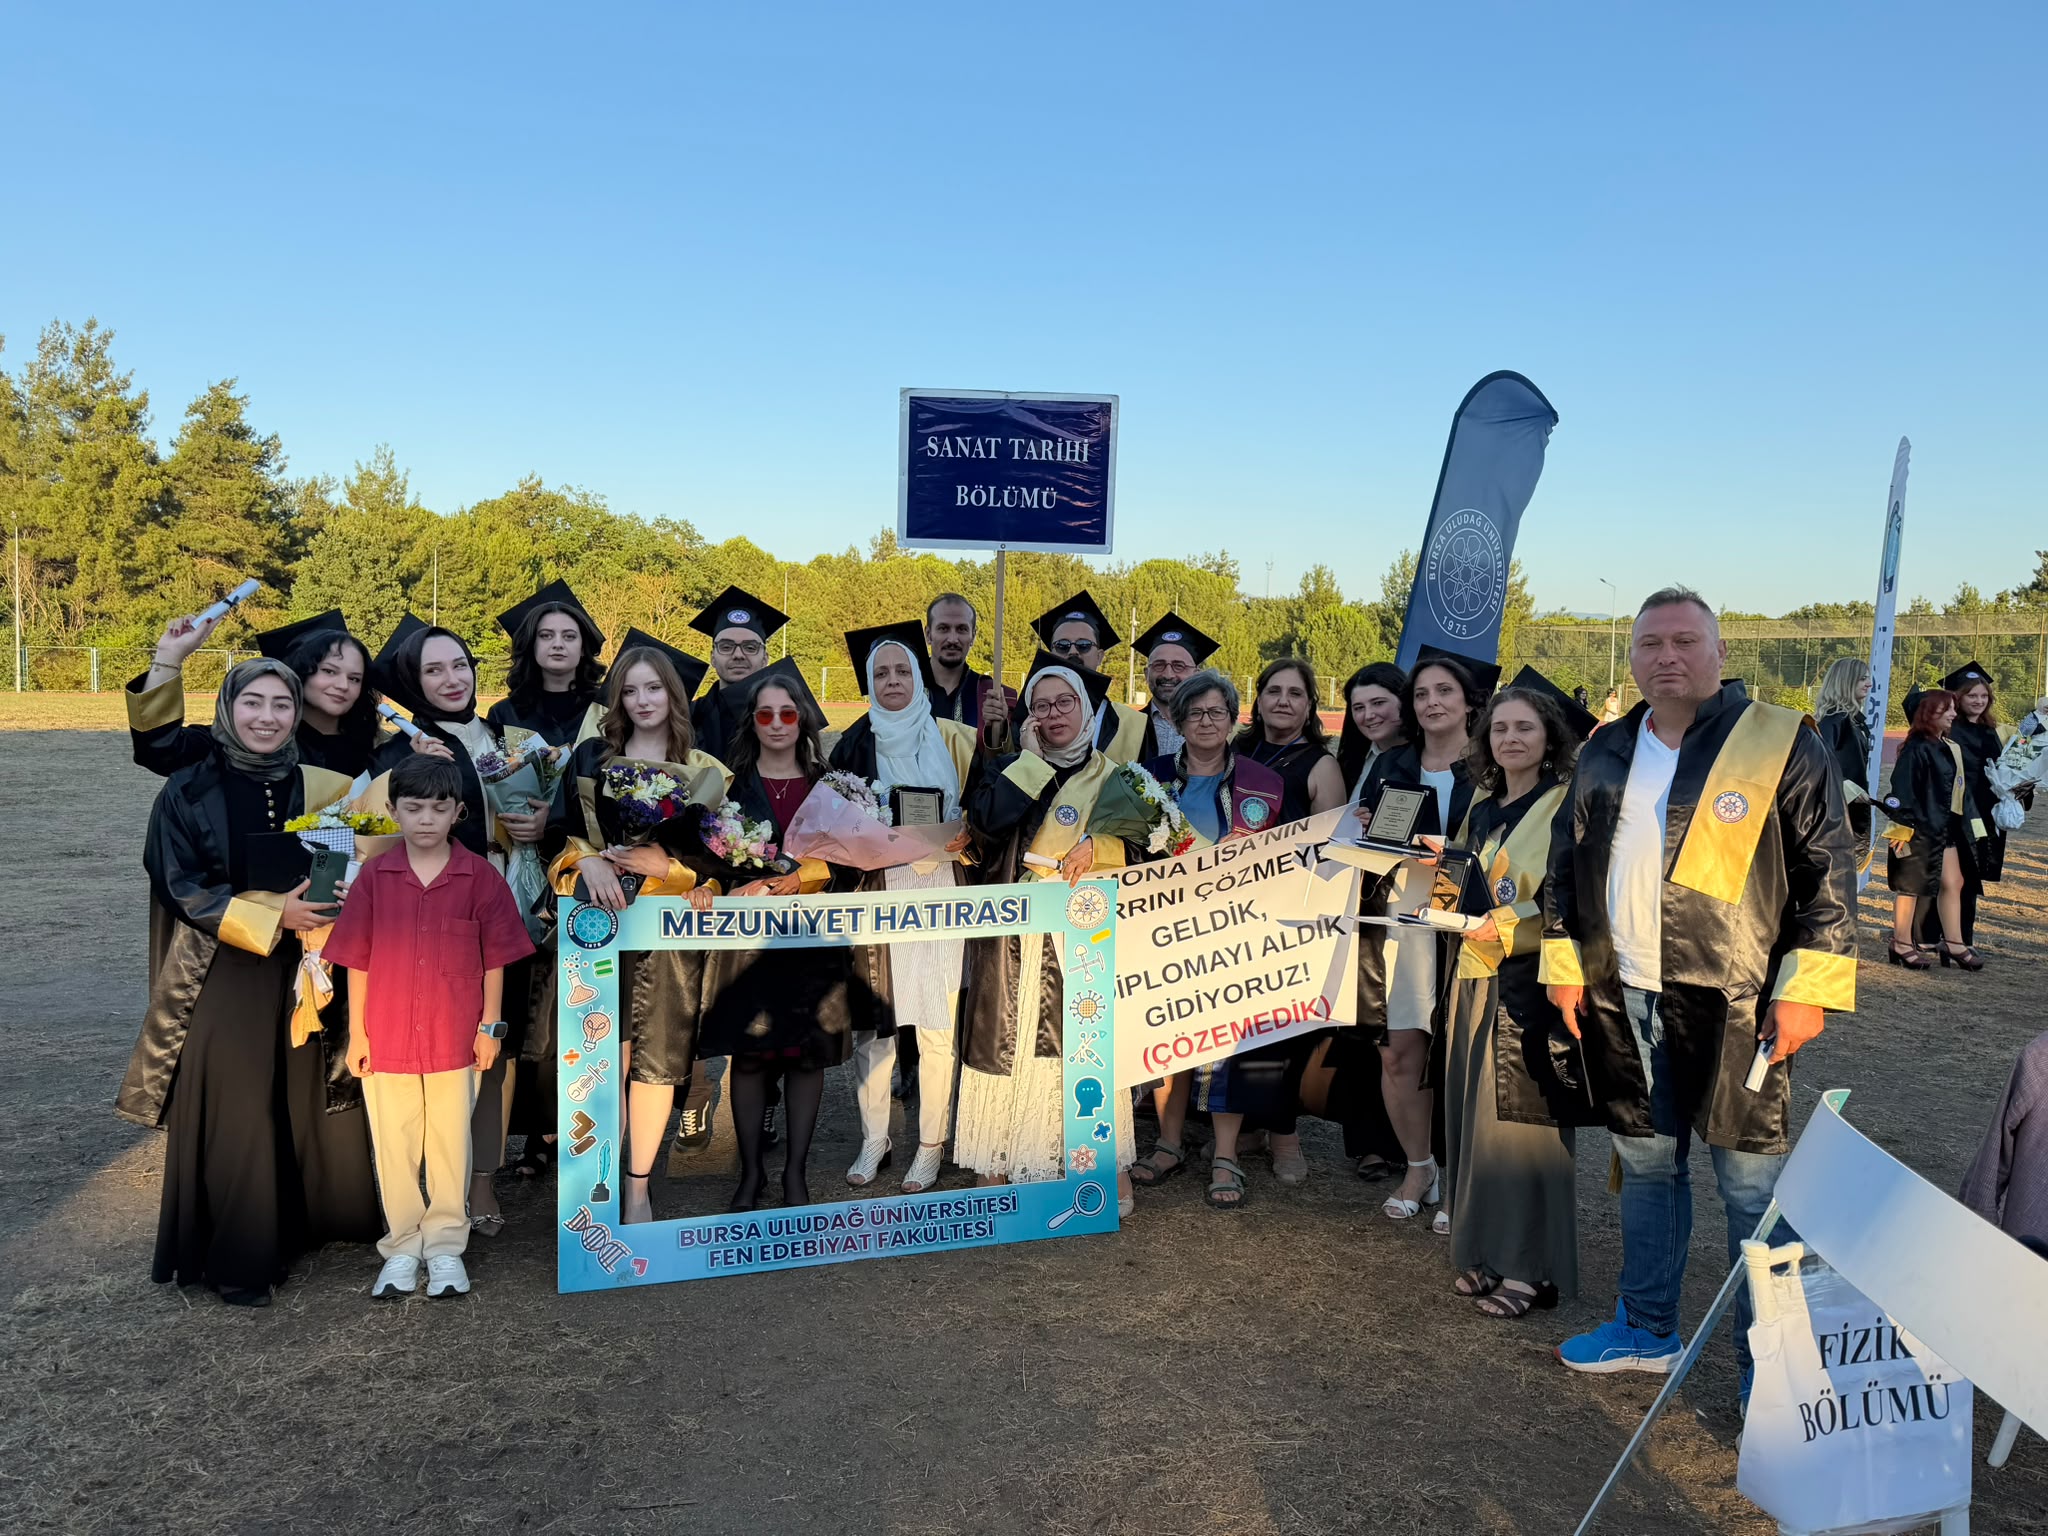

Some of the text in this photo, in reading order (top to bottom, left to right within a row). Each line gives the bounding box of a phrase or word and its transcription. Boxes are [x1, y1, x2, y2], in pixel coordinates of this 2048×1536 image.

[927, 435, 1090, 463] SANAT TARİHİ
[955, 485, 1059, 509] BÖLÜMÜ
[1429, 534, 1447, 580] BURSA
[1445, 513, 1483, 534] ULUDAĞ
[1442, 615, 1467, 636] 1975
[1096, 862, 1188, 889] ONA
[1195, 840, 1332, 901] ÇÖZMEYE
[662, 901, 867, 938] MEZUNİYET
[873, 896, 1031, 934] HATIRASI
[1151, 899, 1268, 948] GELDİK,
[1114, 915, 1348, 1000] İPLOMAYI ALDIK
[1145, 962, 1312, 1028] GİDİYORUZ!
[1142, 995, 1332, 1074] (ÇÖZEMEDİK)
[680, 1190, 1018, 1248] BURSA ULUDAĞ ÜNİVERSİTESİ
[709, 1215, 995, 1268] FEN EDEBİYAT FAKÜLTESİ
[1818, 1316, 1916, 1370] FİZİK
[1798, 1373, 1952, 1443] BÖLÜMÜ
